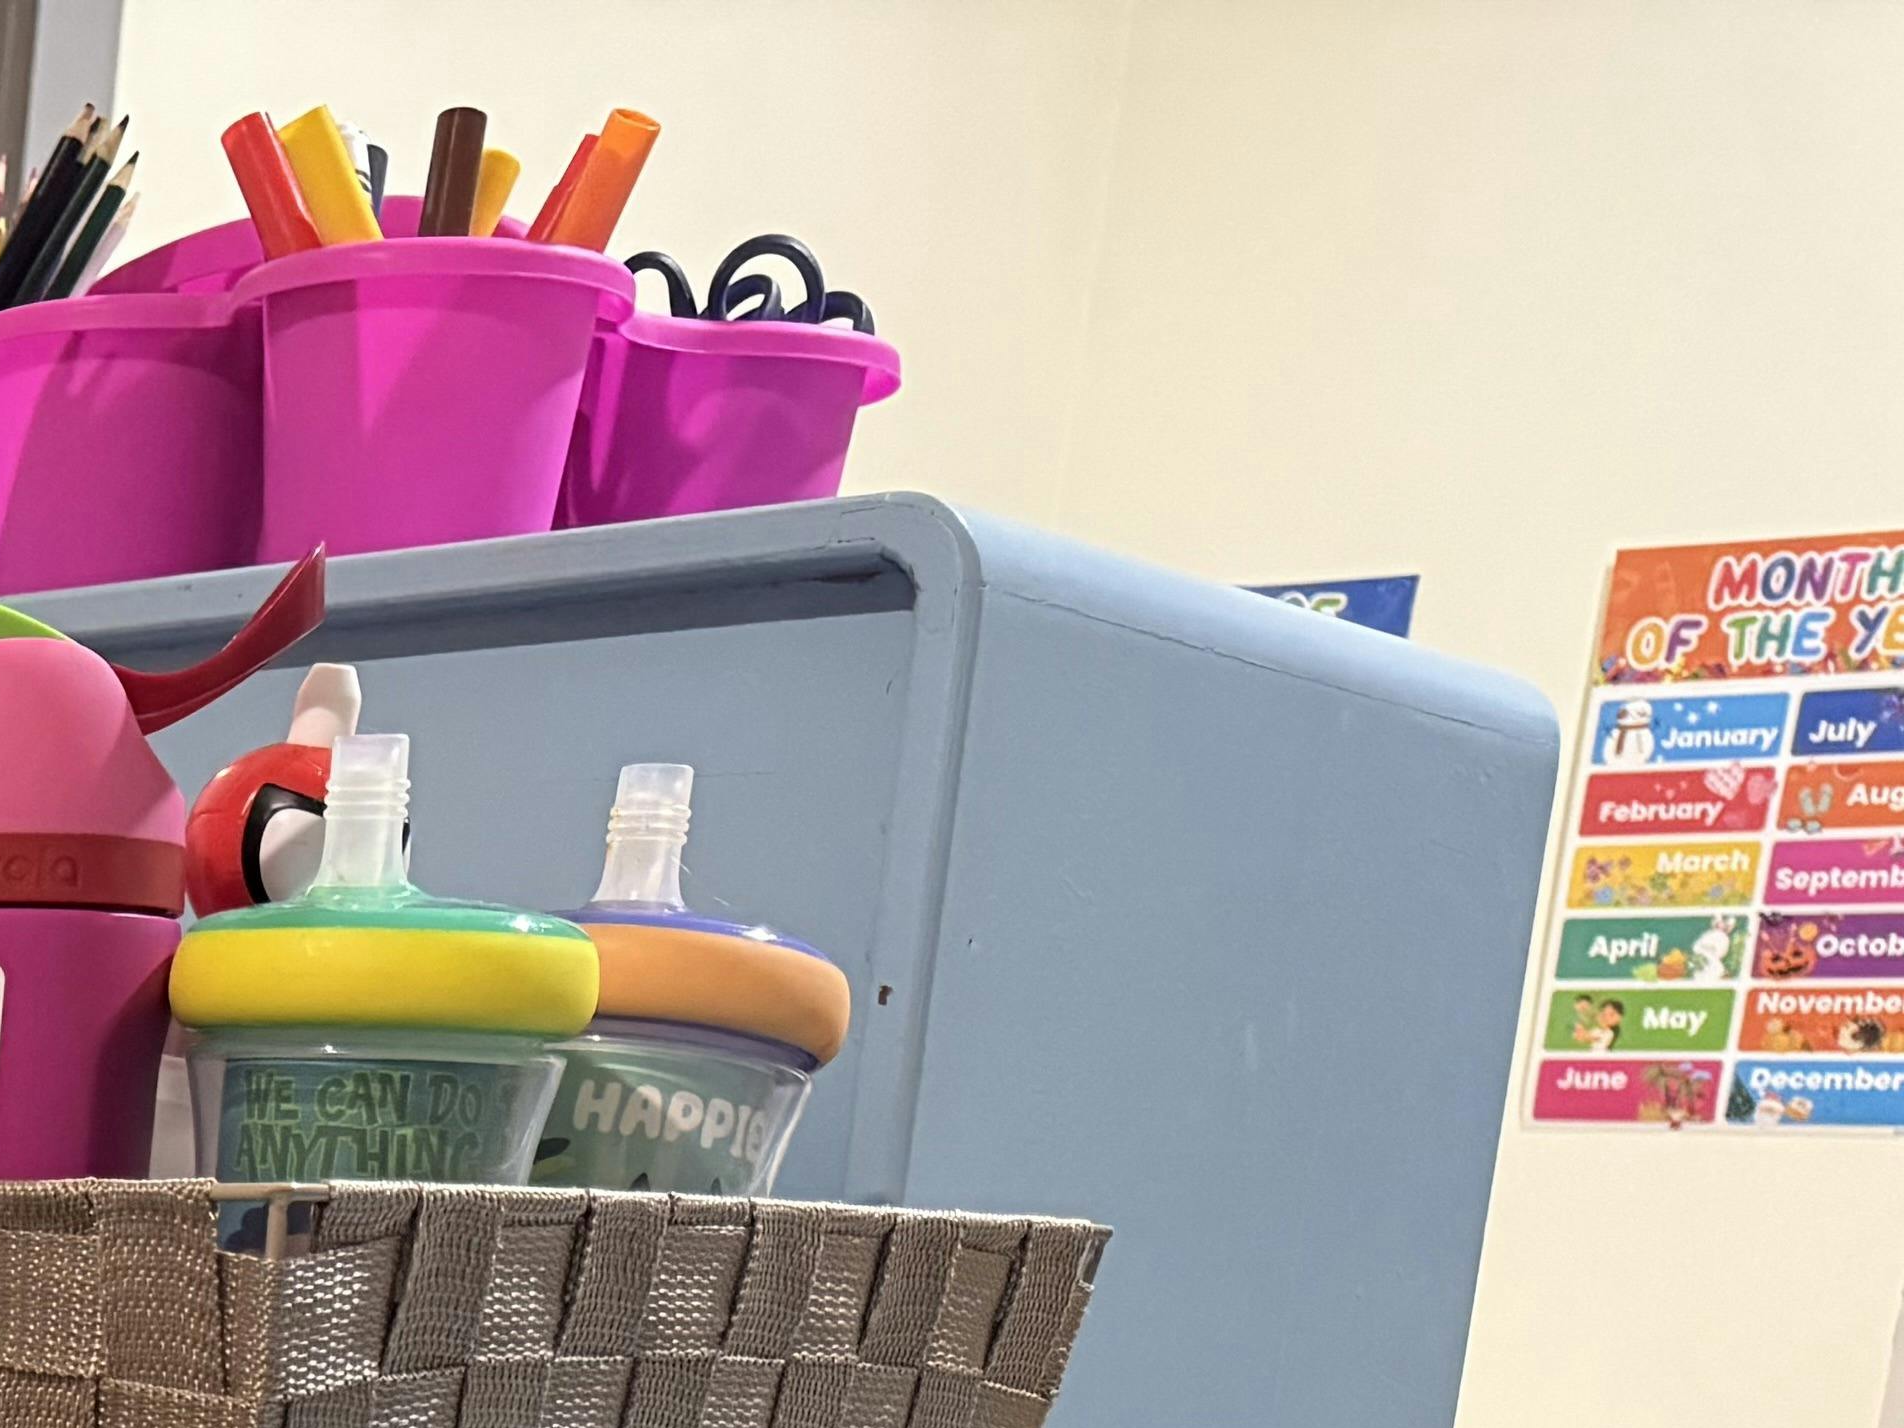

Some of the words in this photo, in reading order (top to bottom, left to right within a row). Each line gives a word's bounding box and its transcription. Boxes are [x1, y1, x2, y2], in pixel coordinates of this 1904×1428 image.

[1629, 616, 1705, 669] OF
[1724, 609, 1832, 662] THE
[1661, 727, 1778, 750] January
[1809, 718, 1876, 747] July
[1599, 801, 1724, 826] February
[1657, 850, 1750, 873] March
[1589, 933, 1659, 963] April
[1757, 991, 1904, 1015] Novembe
[1643, 1007, 1707, 1036] May
[1557, 1067, 1627, 1090] June
[1750, 1067, 1904, 1091] December
[243, 1069, 300, 1123] WE
[315, 1069, 414, 1127] CAN
[427, 1072, 484, 1129] DO
[235, 1124, 483, 1183] ANYTHING
